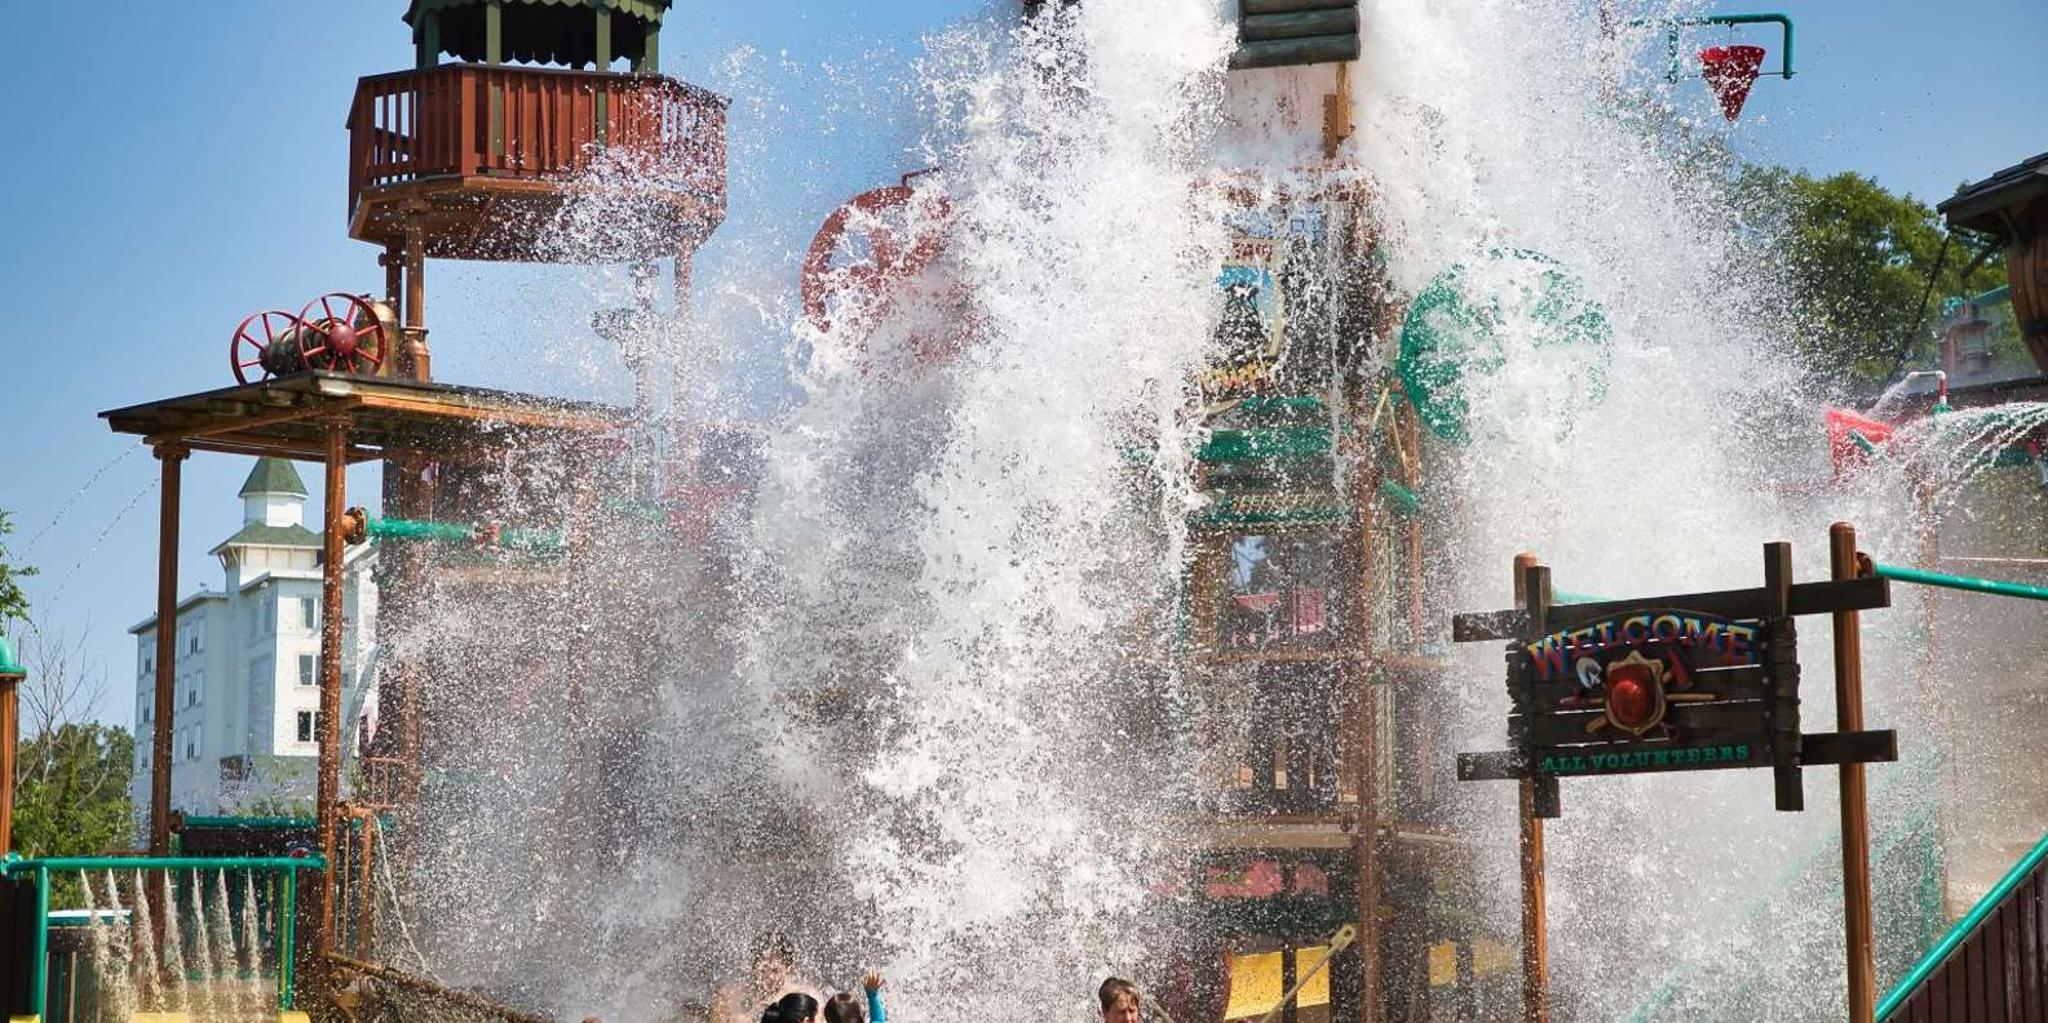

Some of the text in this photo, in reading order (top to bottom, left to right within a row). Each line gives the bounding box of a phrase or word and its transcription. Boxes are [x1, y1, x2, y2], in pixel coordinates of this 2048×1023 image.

[1527, 614, 1758, 680] WELCOME
[1543, 744, 1749, 772] ALL VOLUNTEERS
